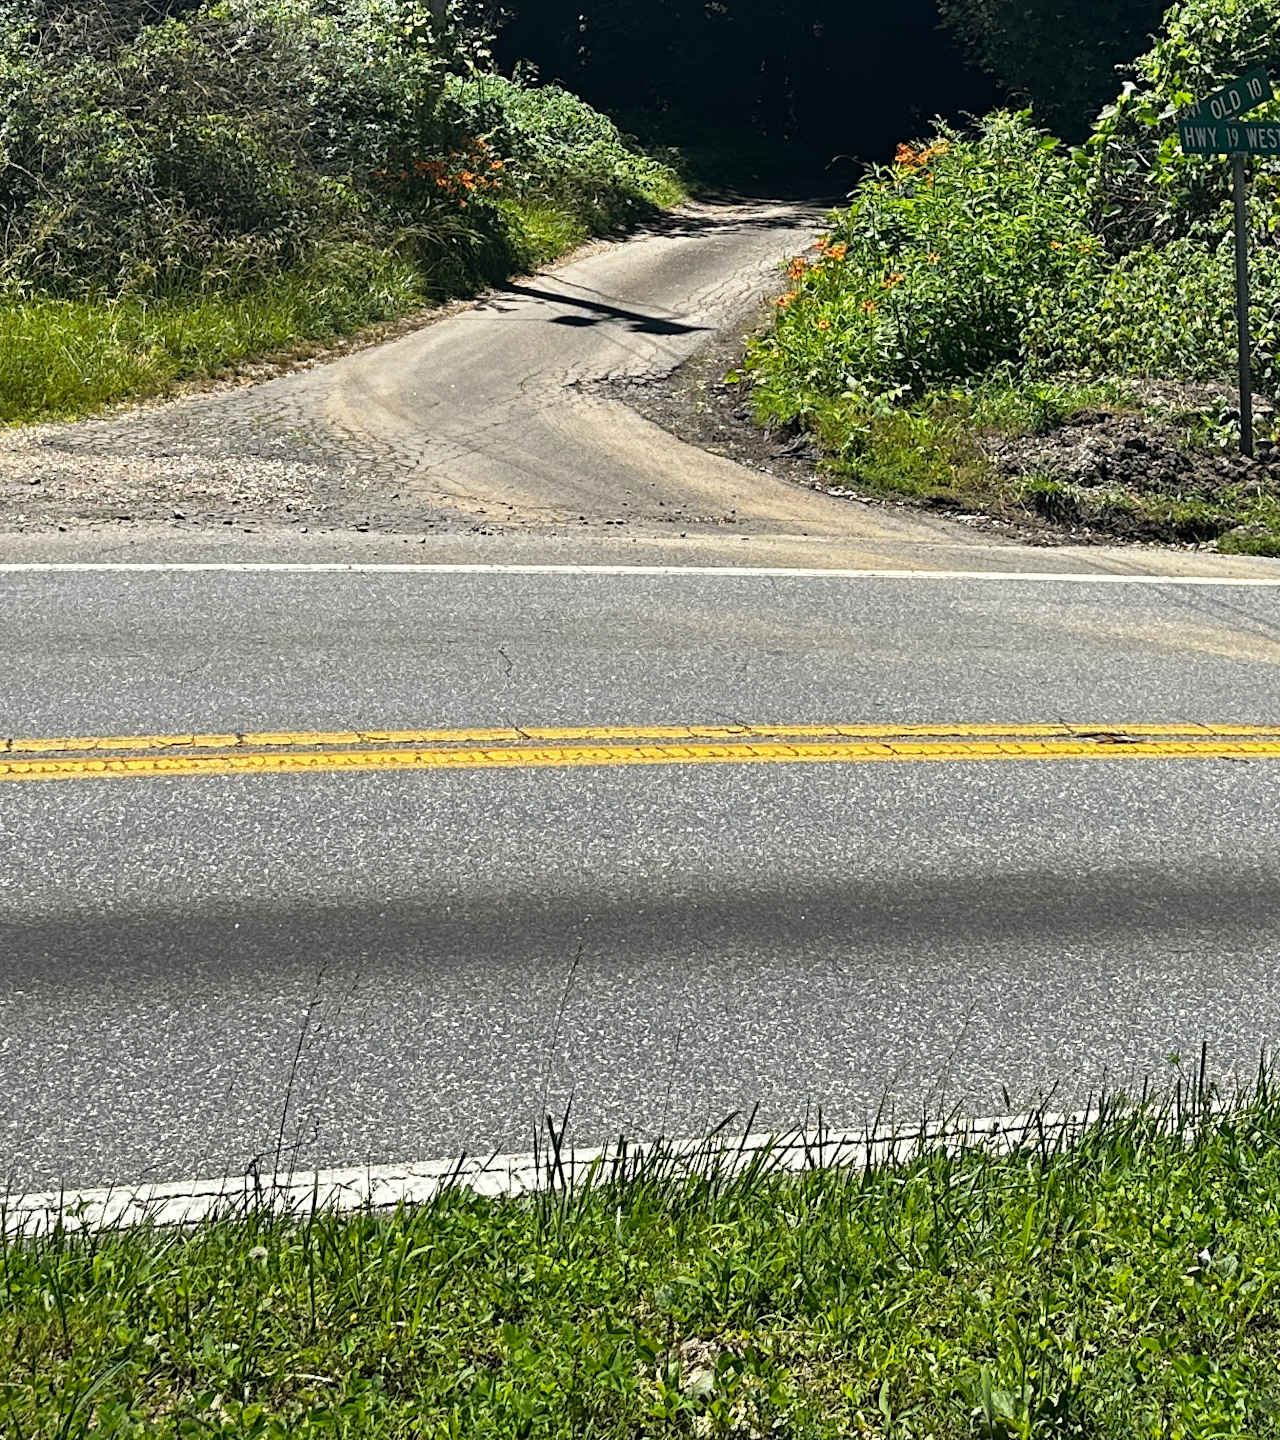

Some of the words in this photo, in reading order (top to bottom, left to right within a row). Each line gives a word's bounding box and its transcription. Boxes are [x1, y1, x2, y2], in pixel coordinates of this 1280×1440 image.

[1210, 89, 1241, 120] OLD
[1246, 77, 1263, 100] 10
[1226, 127, 1239, 148] 19
